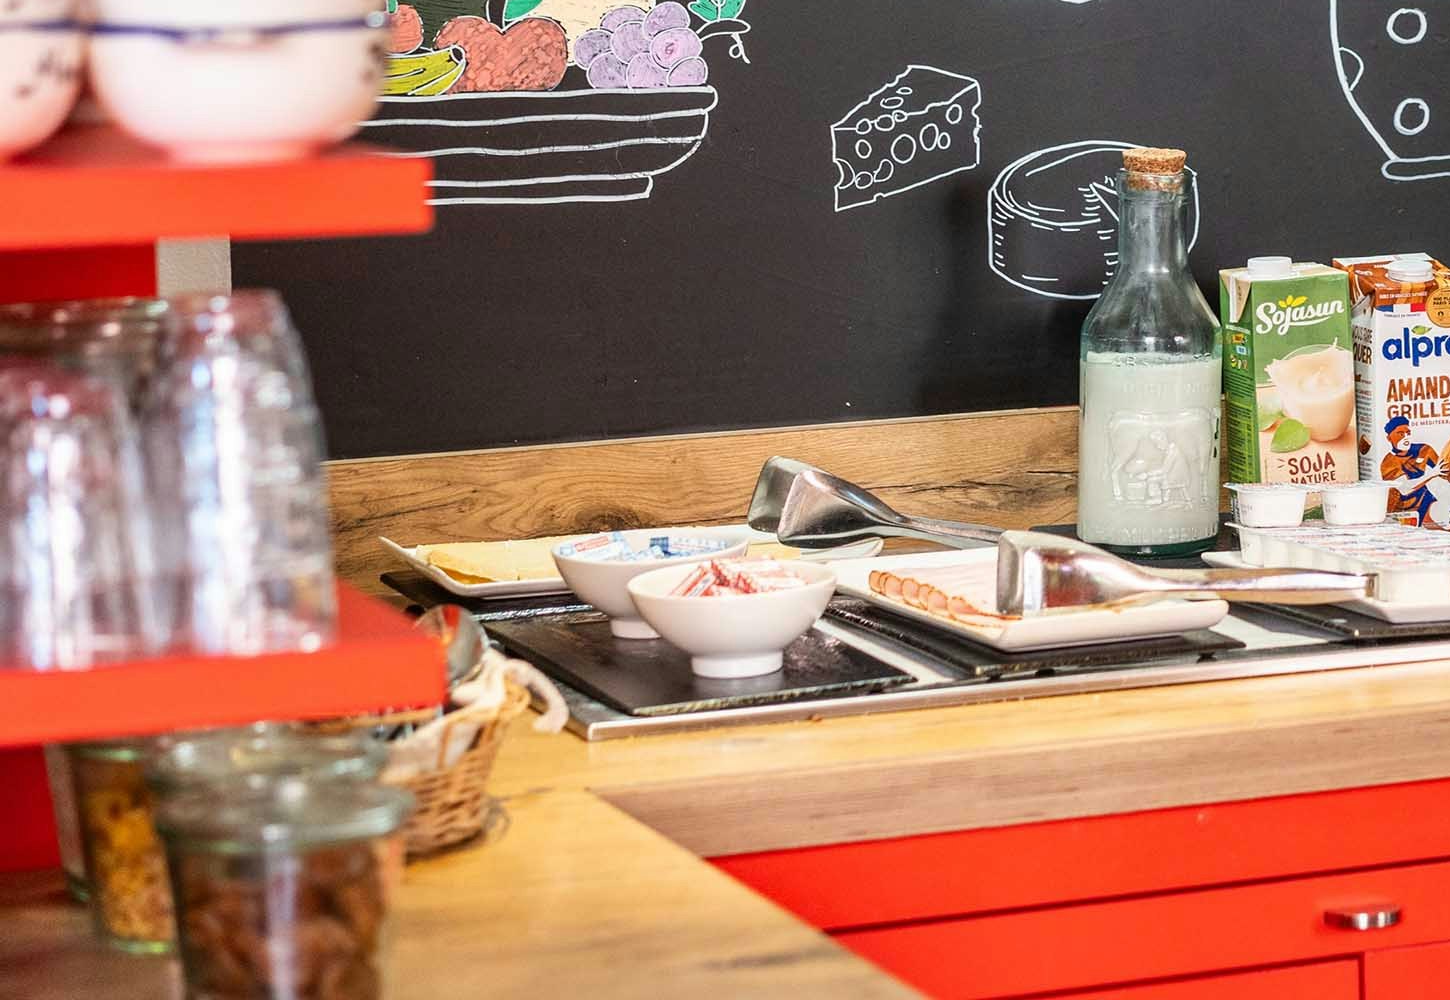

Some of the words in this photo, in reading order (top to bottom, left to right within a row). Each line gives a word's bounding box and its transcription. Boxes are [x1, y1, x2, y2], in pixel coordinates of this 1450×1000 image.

[1255, 300, 1345, 336] Sojasun
[1352, 342, 1373, 365] QUER
[1287, 451, 1336, 476] SOJA
[1290, 470, 1337, 485] NATURE
